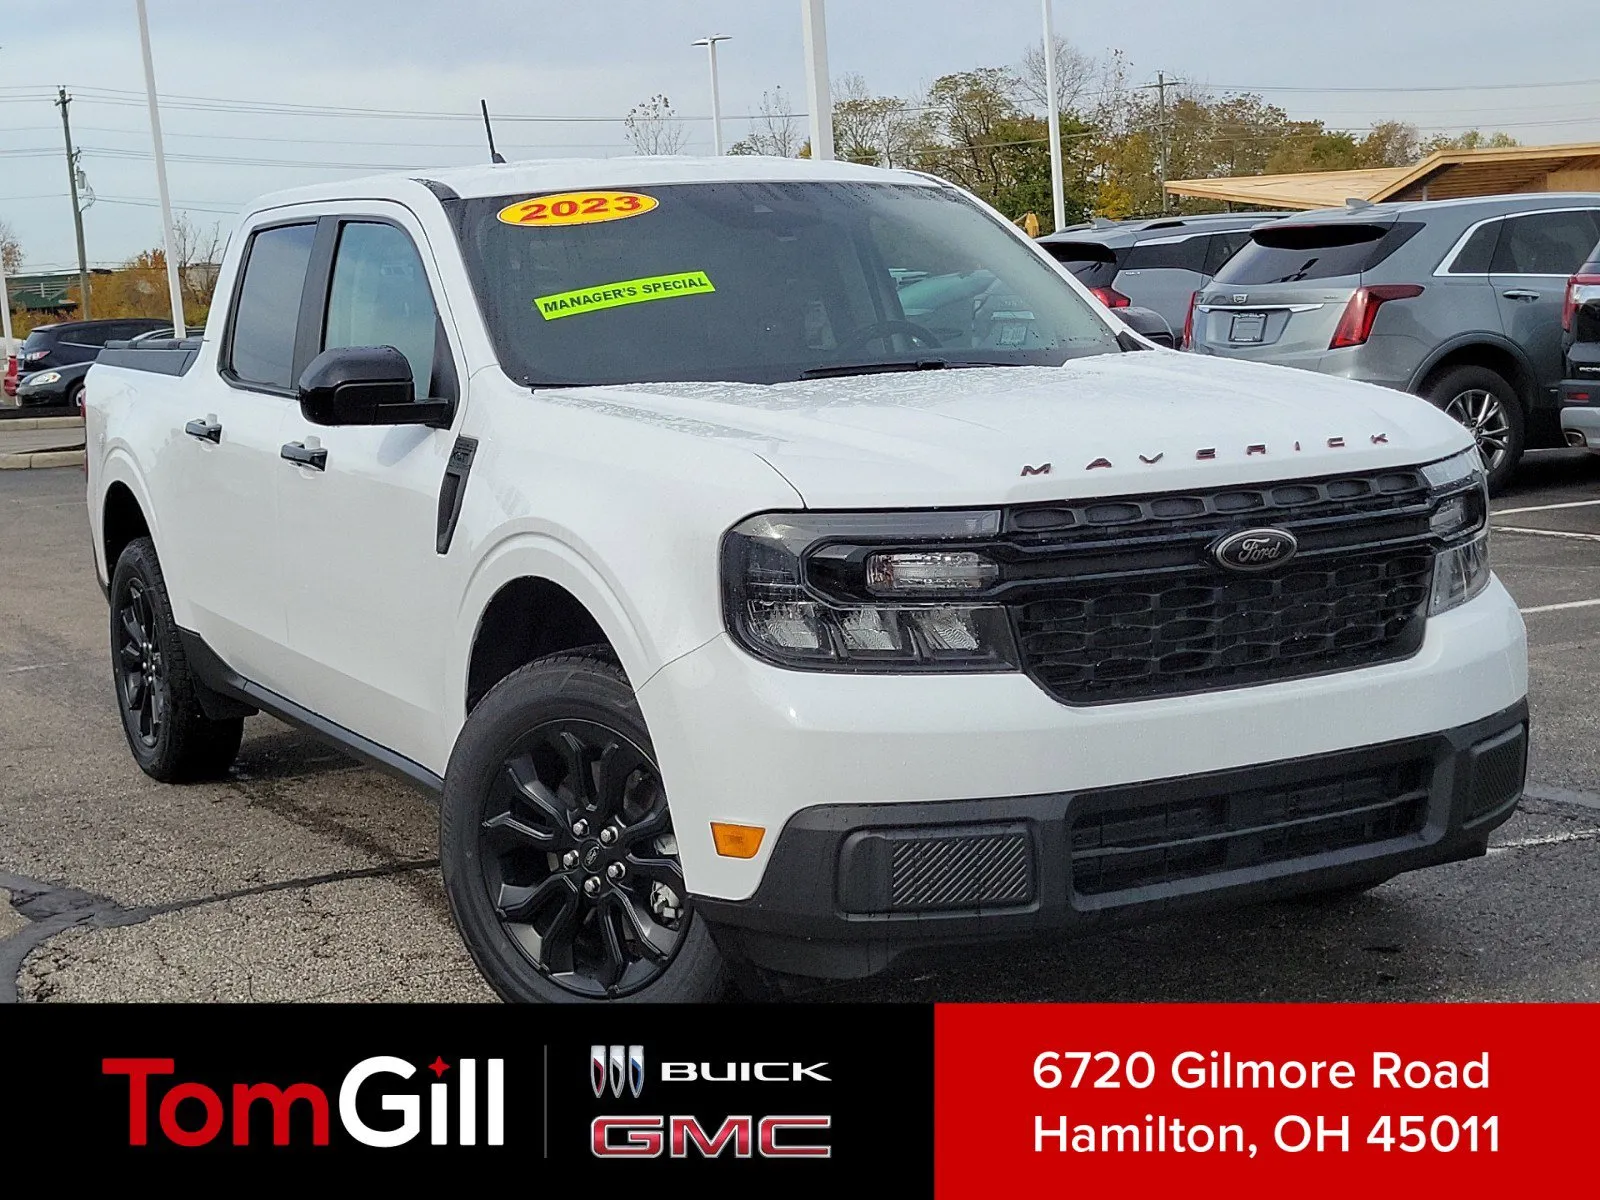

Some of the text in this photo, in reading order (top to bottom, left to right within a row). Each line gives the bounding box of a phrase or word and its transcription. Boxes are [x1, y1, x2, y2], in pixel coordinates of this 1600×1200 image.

[519, 196, 641, 222] 2023
[543, 277, 707, 313] MANAGER'S SPECIAL
[1020, 433, 1389, 477] MAVERICK
[1238, 537, 1281, 562] Ford
